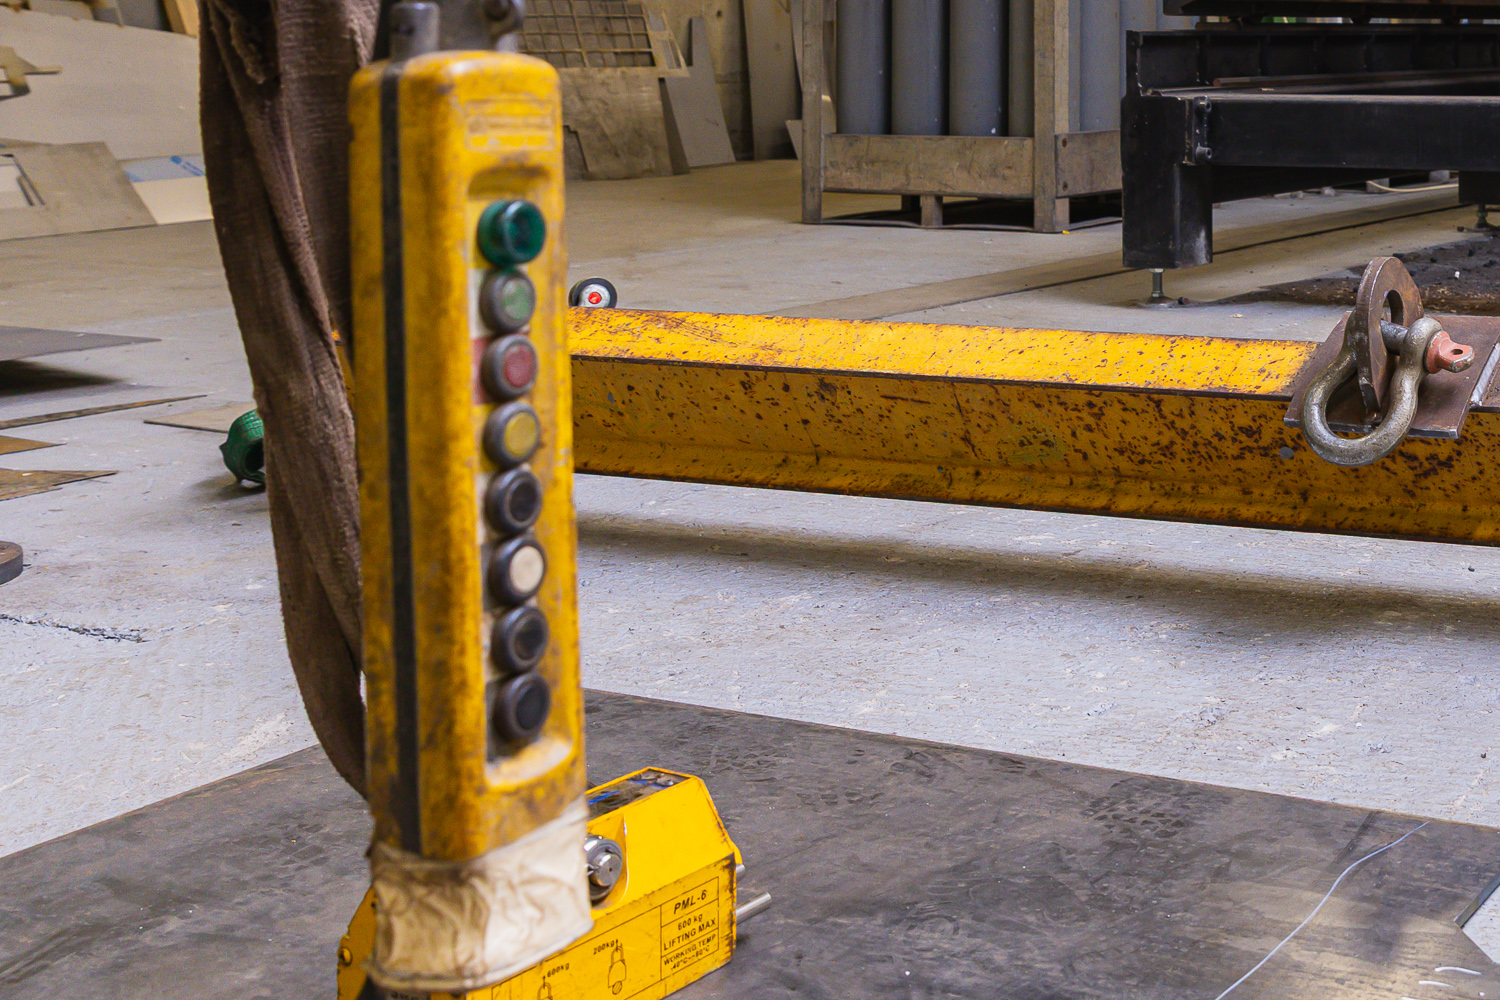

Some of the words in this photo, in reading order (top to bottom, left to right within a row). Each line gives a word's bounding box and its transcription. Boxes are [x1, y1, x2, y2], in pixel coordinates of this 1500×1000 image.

[673, 889, 707, 914] PML-6
[663, 928, 697, 951] LIFTING
[698, 918, 716, 933] MAX
[677, 917, 692, 931] 600
[693, 914, 703, 923] kg
[663, 944, 697, 966] WORKING
[698, 933, 717, 949] TEMP
